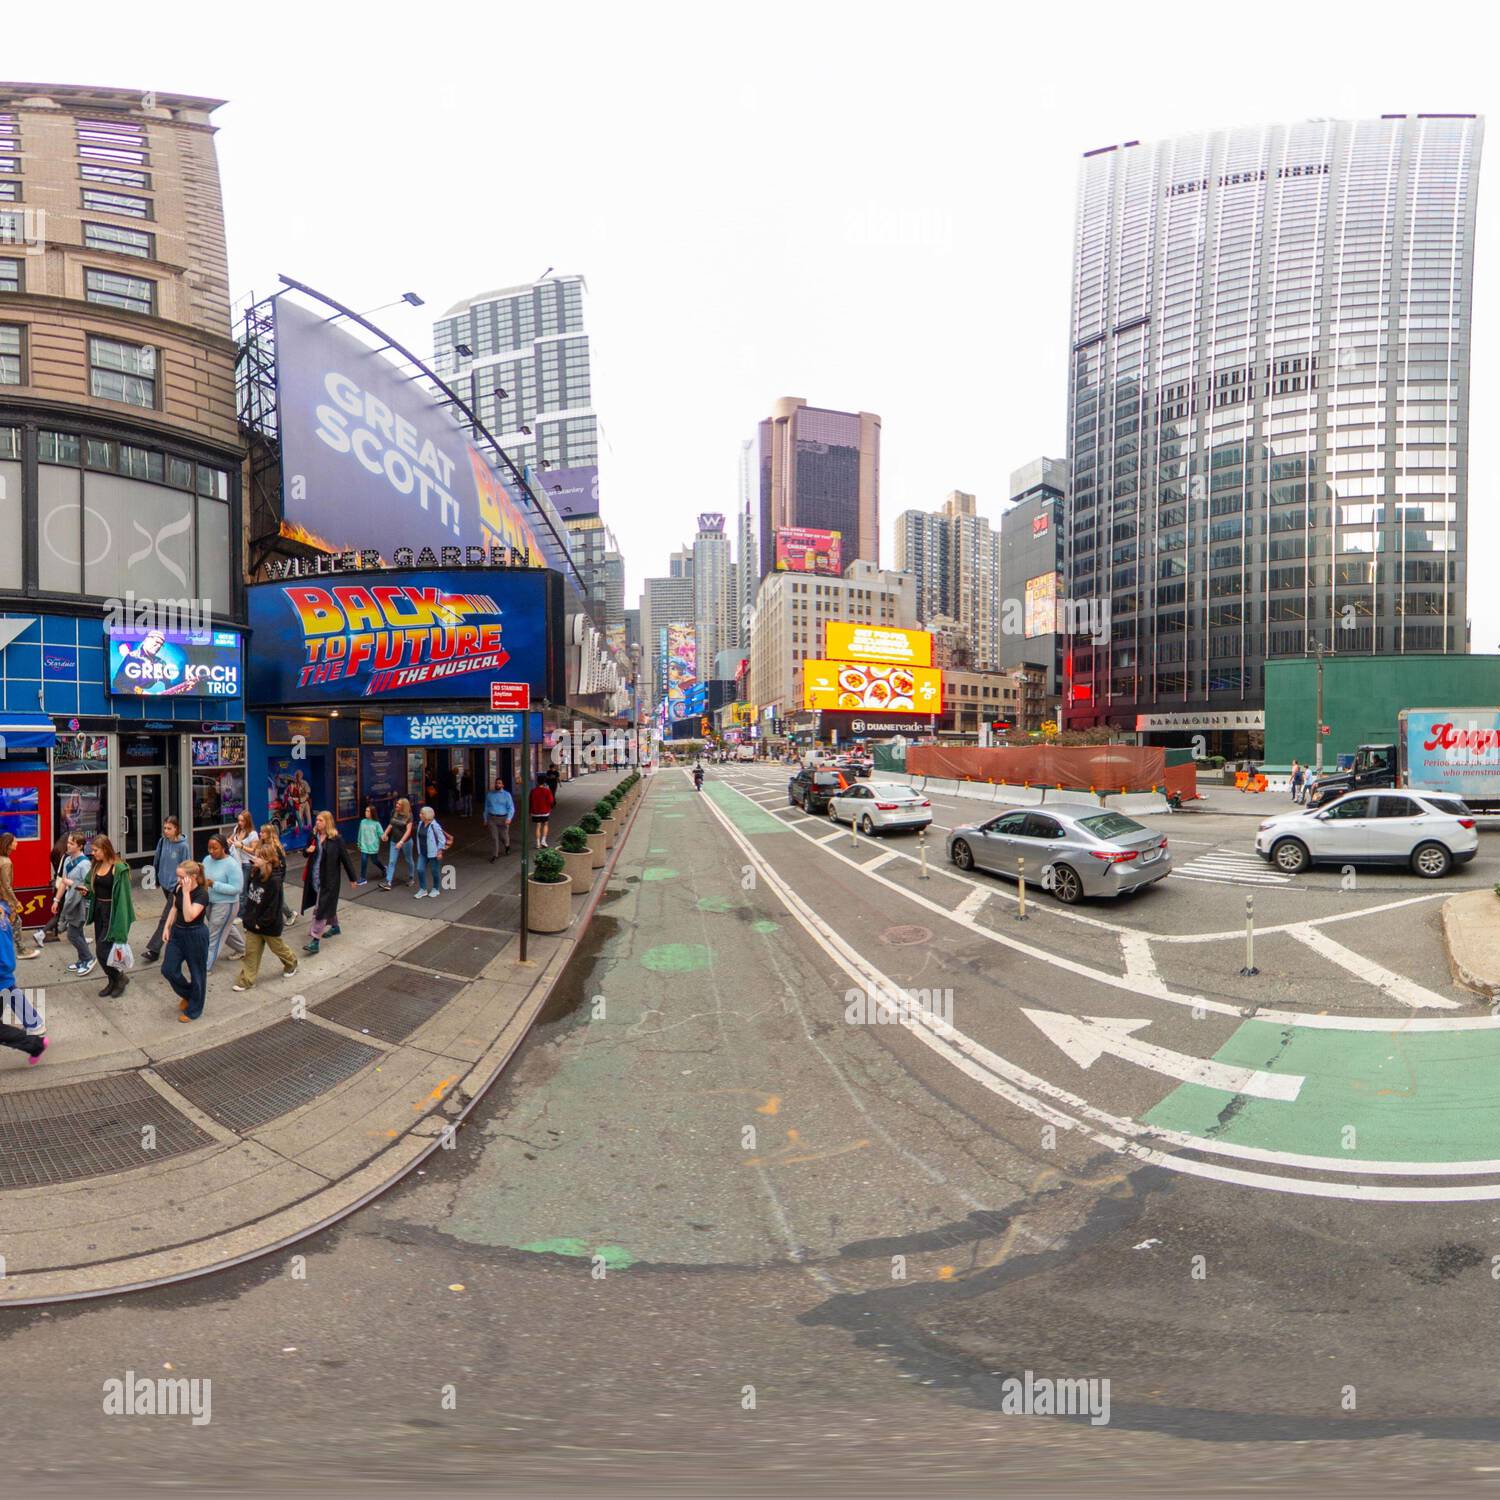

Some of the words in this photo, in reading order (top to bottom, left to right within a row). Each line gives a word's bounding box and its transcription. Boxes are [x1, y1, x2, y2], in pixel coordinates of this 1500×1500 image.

[324, 372, 456, 489] GREAT
[316, 404, 461, 537] SCOTT!
[1033, 529, 1048, 540] hotel
[263, 550, 382, 580] WINTER
[393, 546, 530, 567] GARDEN
[282, 586, 478, 635] BACK
[304, 635, 347, 664] TO
[344, 623, 503, 678] FUTURE
[125, 662, 179, 680] GREG
[185, 664, 237, 682] KOCH
[297, 660, 345, 688] THE
[396, 666, 431, 687] THE
[432, 654, 500, 679] MUSICAL
[207, 681, 237, 694] TRIO
[422, 715, 514, 725] JAW-DROPPING
[1149, 716, 1228, 726] PARAMOUNT
[1423, 759, 1450, 767] Period
[1443, 768, 1461, 777] who
